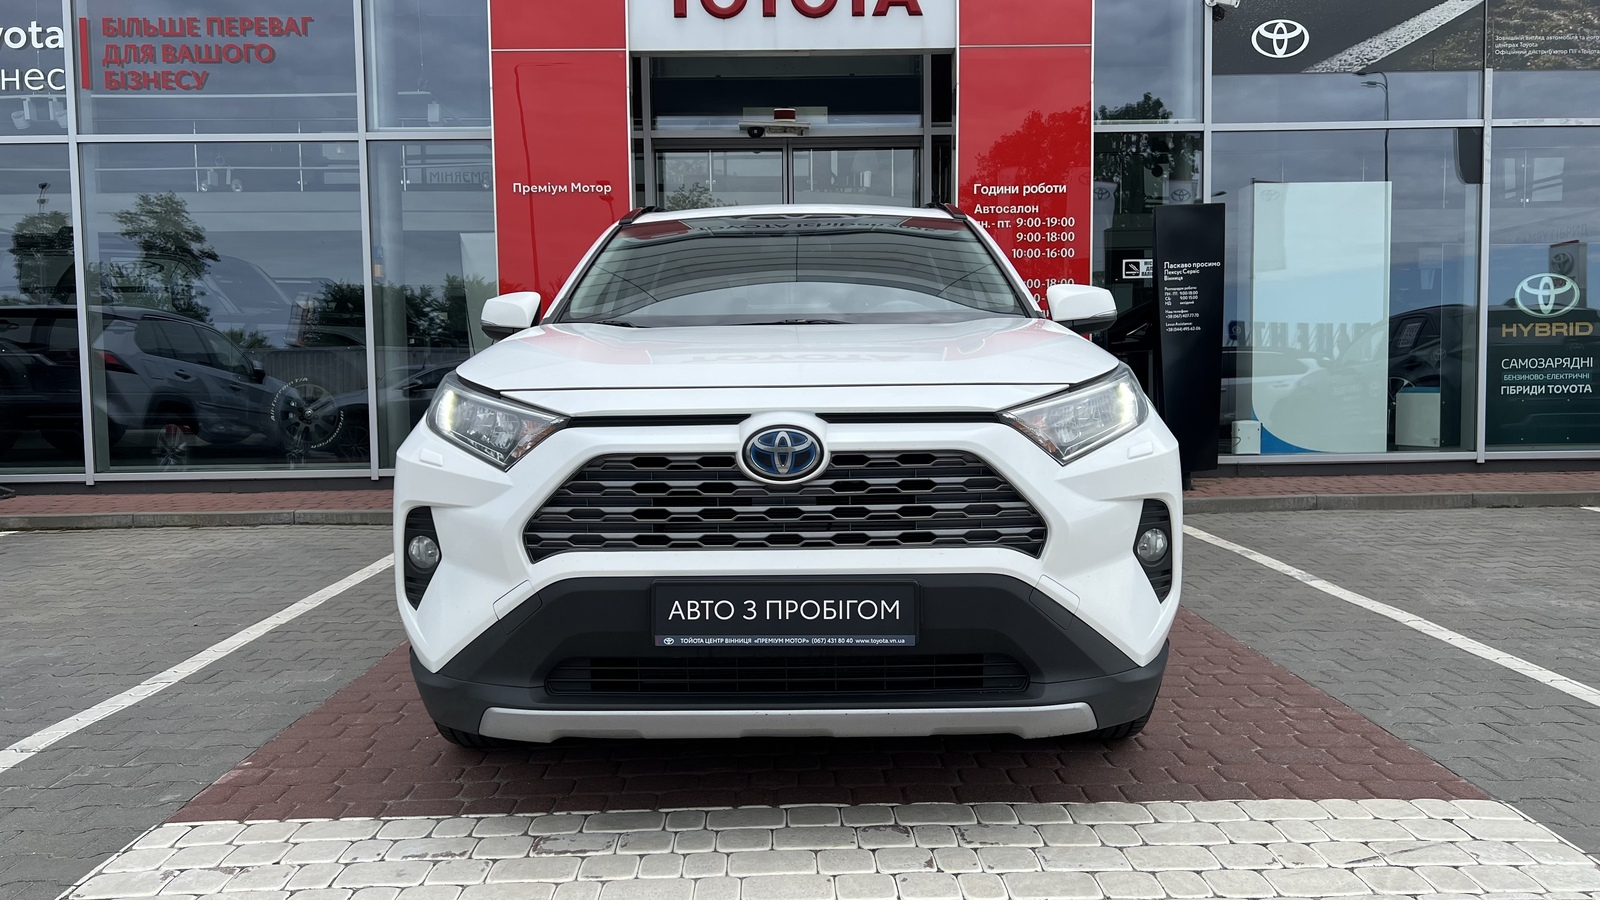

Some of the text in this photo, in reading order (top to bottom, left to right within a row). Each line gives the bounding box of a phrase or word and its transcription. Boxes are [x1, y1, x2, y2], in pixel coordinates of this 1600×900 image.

[102, 17, 313, 36] БІЛЬШЕ ПЕРЕВАГ
[0, 21, 64, 49] ota
[102, 43, 275, 66] ДЛЯ ВАШОГО
[104, 71, 207, 90] БІЗНЕСУ
[513, 182, 612, 195] Преміум Мотор
[973, 182, 1067, 197] Години роботи
[973, 204, 1039, 214] Автосалон
[1016, 217, 1075, 228] 9:00-19:00
[1016, 232, 1075, 242] 9:00-18:00
[1011, 247, 1075, 258] 10:00-16:00
[1501, 321, 1593, 337] HYBRID
[1501, 357, 1593, 369] САМОЗАРЯДНІ
[1503, 373, 1590, 381] БЕНЗИНОВО-ЕЛЕКТРИЧНІ
[1501, 384, 1592, 395] ГІБРИДИ TOYOTA
[668, 599, 900, 620] АВТО З ПРОБІГОМ
[811, 637, 827, 645] (067)
